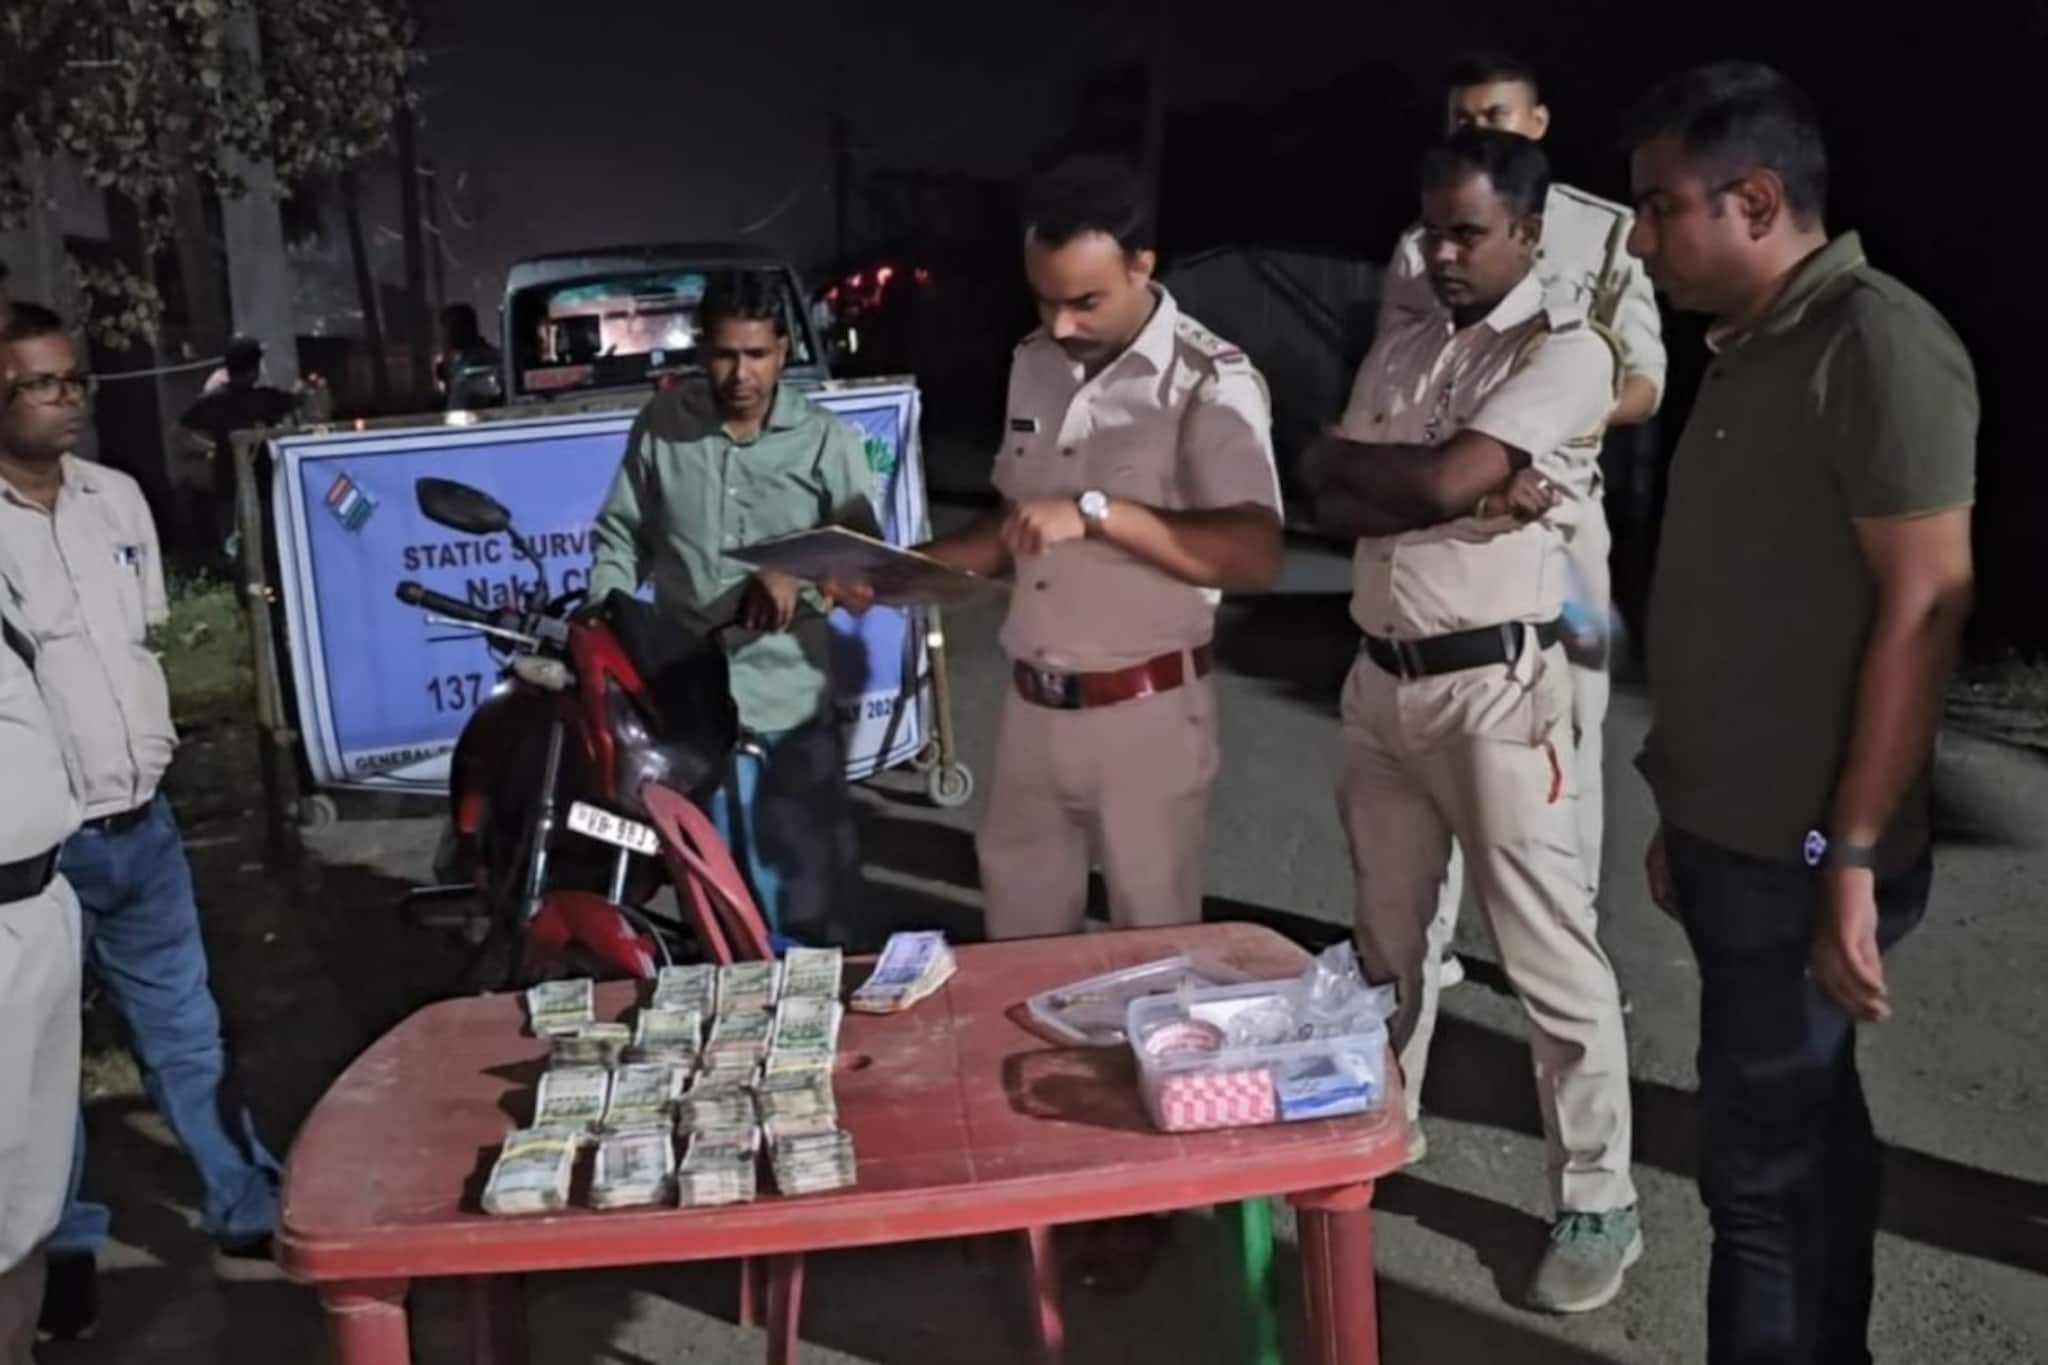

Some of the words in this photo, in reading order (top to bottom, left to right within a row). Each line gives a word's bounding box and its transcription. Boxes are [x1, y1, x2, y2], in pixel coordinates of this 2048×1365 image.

[403, 538, 501, 571] STATIC
[466, 573, 549, 612] Nak
[426, 672, 483, 713] 137
[866, 697, 899, 719] 202
